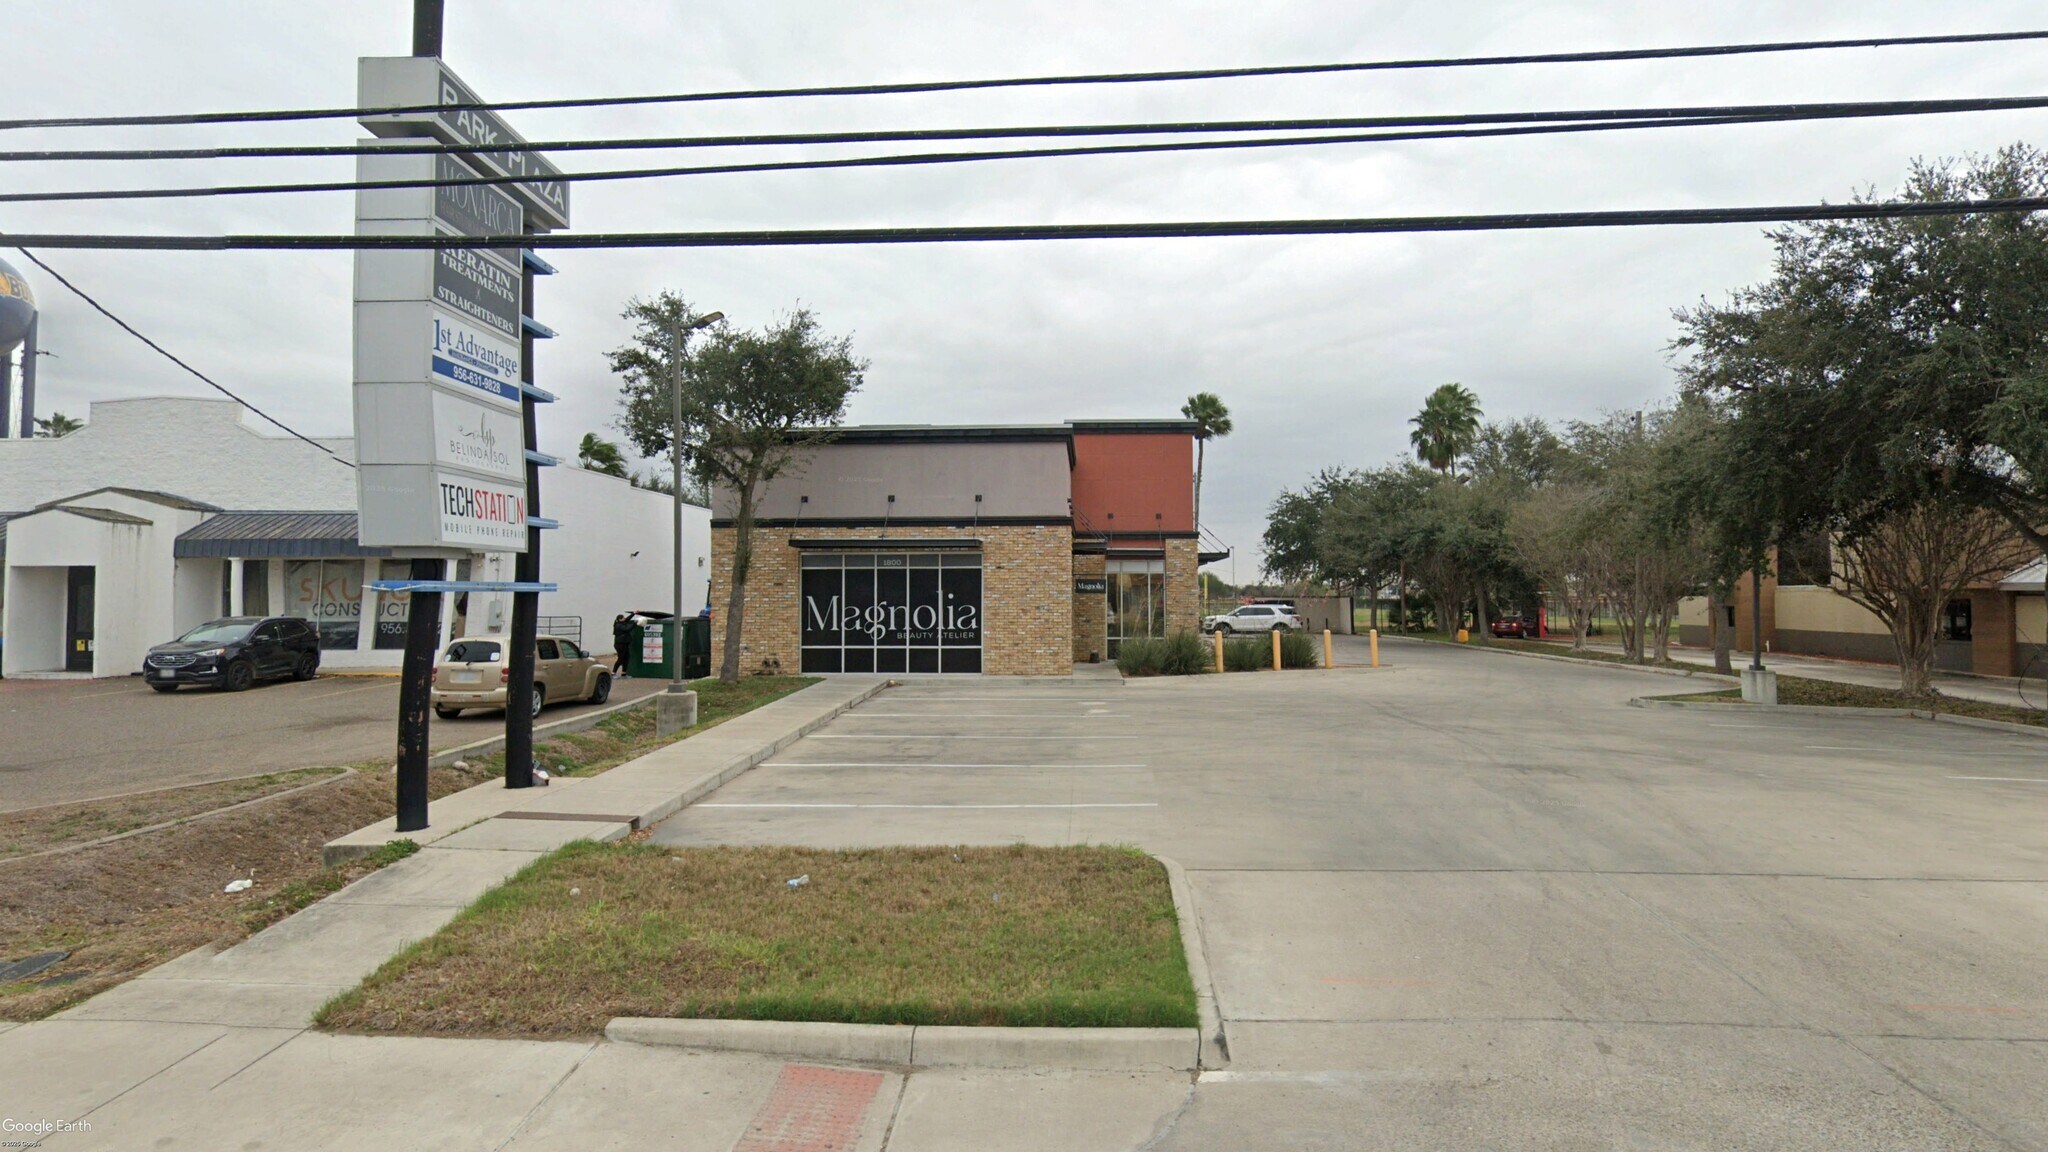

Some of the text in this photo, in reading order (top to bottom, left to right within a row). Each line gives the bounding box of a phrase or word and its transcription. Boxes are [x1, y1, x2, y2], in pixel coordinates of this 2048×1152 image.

[442, 80, 565, 211] PARK PLAZA
[440, 160, 515, 236] MONARCA
[440, 252, 515, 302] TREATMENTS
[438, 285, 514, 334] STRAIGHTENERS
[433, 319, 452, 352] 1st
[455, 330, 518, 378] Advantage
[450, 440, 490, 461] BELINDA
[444, 522, 525, 539] MOBILE PHONE REPAIR
[806, 589, 979, 640] Magnolia
